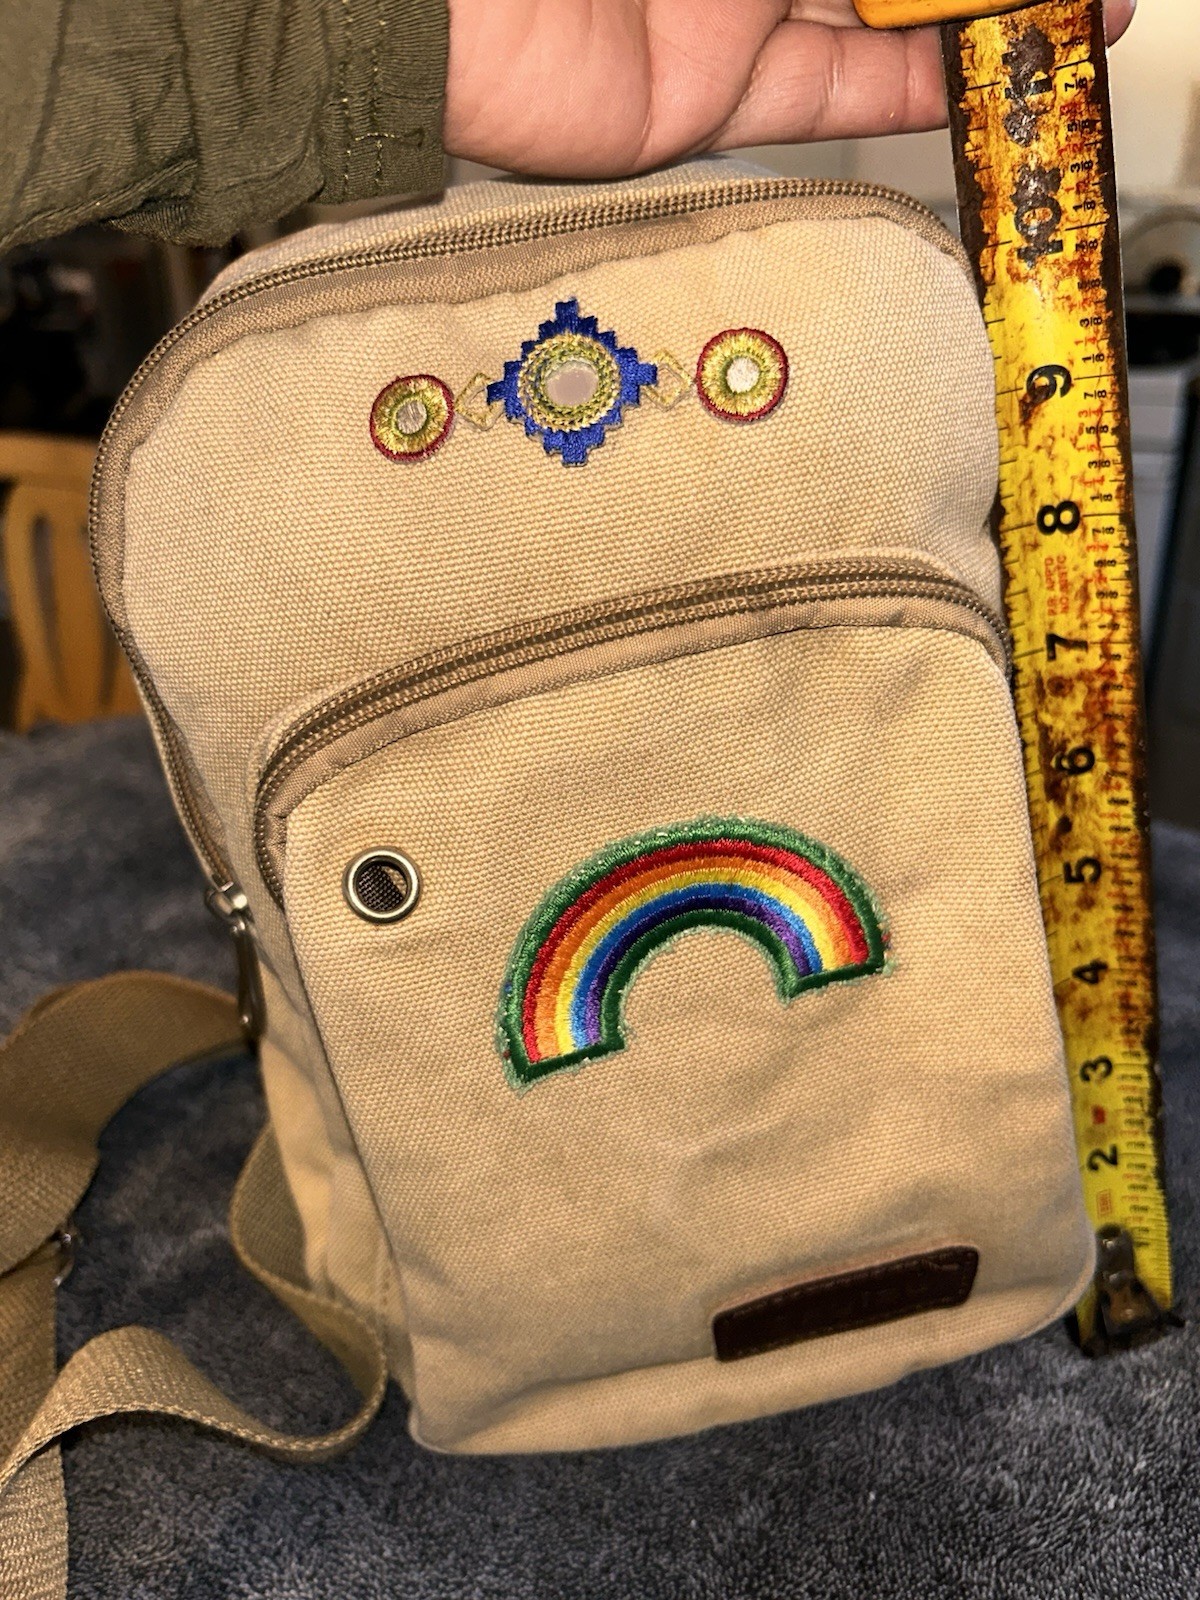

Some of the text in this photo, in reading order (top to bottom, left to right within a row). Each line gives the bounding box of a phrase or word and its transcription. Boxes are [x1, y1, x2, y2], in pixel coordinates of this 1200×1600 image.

[1026, 364, 1072, 402] 9
[1037, 500, 1081, 536] 8
[1046, 633, 1089, 661] 7
[1055, 746, 1096, 776] 6
[1063, 856, 1102, 885] 5
[1072, 958, 1109, 985] 4
[1079, 1055, 1114, 1084] 3
[1087, 1144, 1120, 1172] 2
